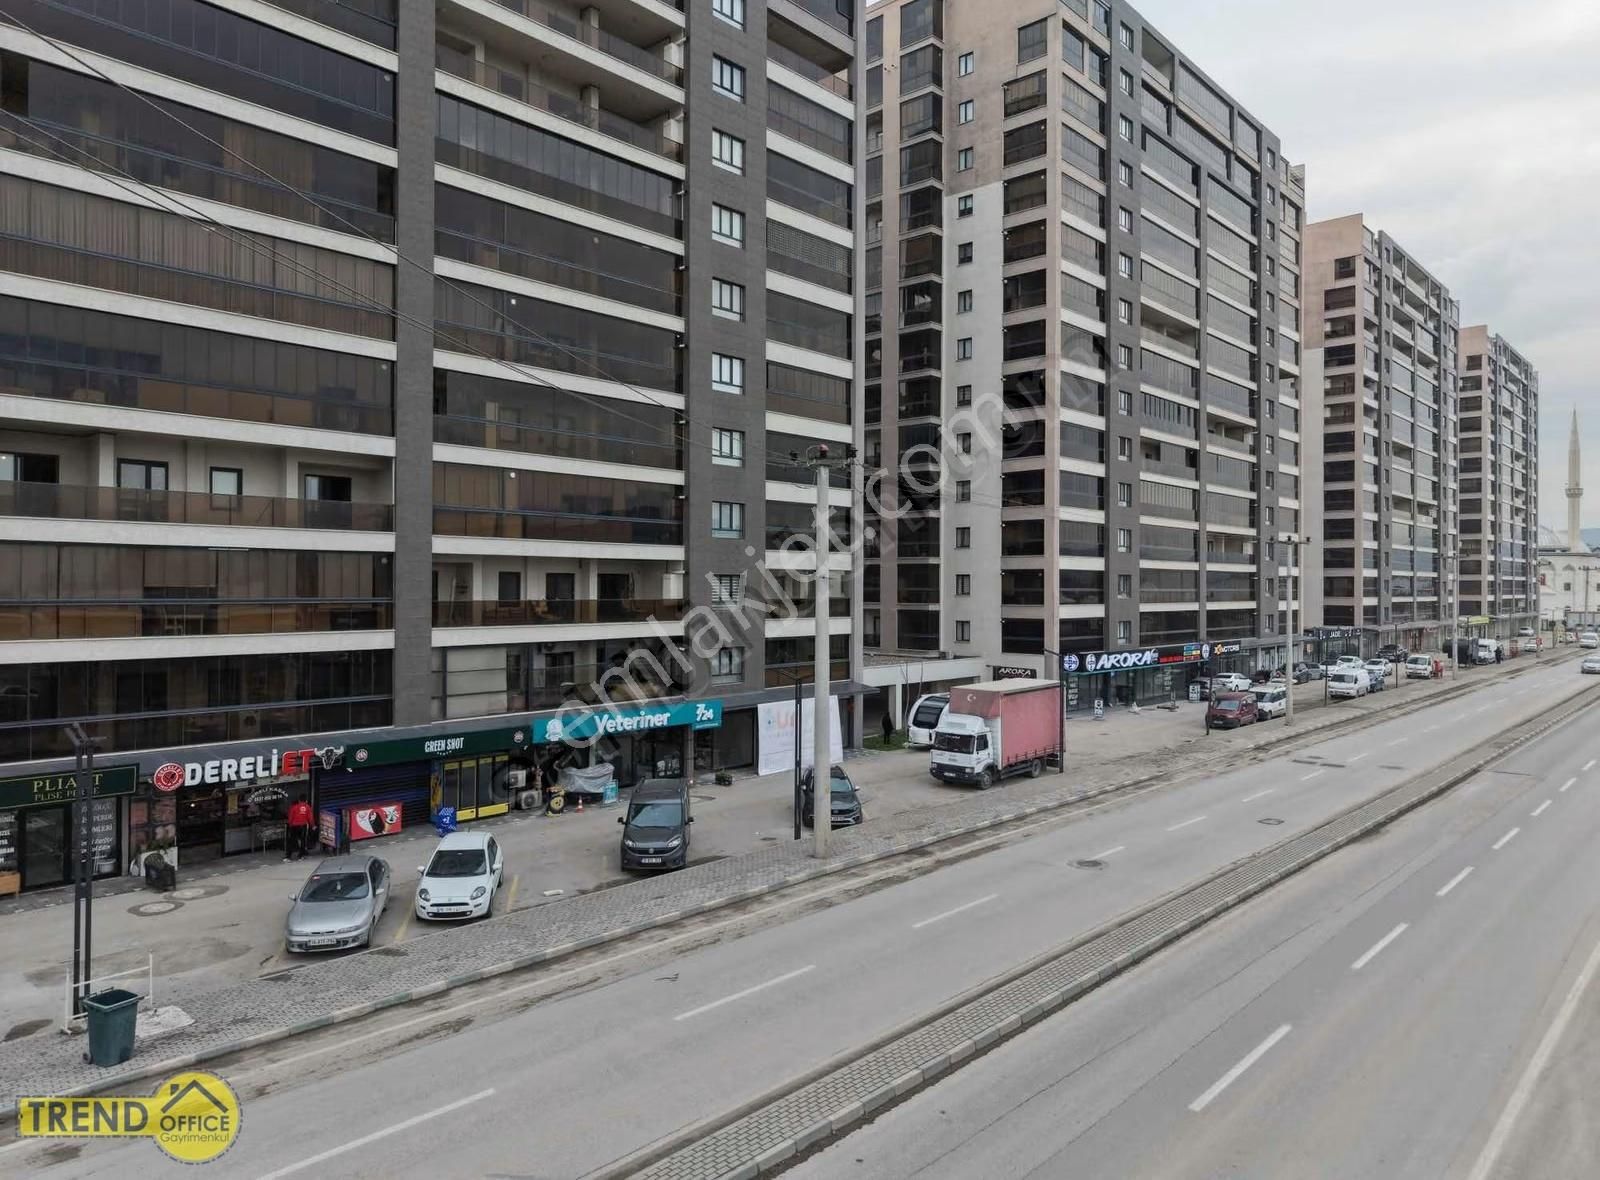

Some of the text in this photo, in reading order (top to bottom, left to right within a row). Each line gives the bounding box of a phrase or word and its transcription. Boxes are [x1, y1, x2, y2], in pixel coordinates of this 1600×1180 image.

[1095, 651, 1152, 670] ARORA
[593, 710, 671, 733] Veteriner
[424, 739, 446, 753] GREEN
[446, 737, 465, 750] SHOT
[184, 749, 278, 787] DERELİ
[282, 749, 315, 775] ET
[33, 773, 103, 793] PLIAT
